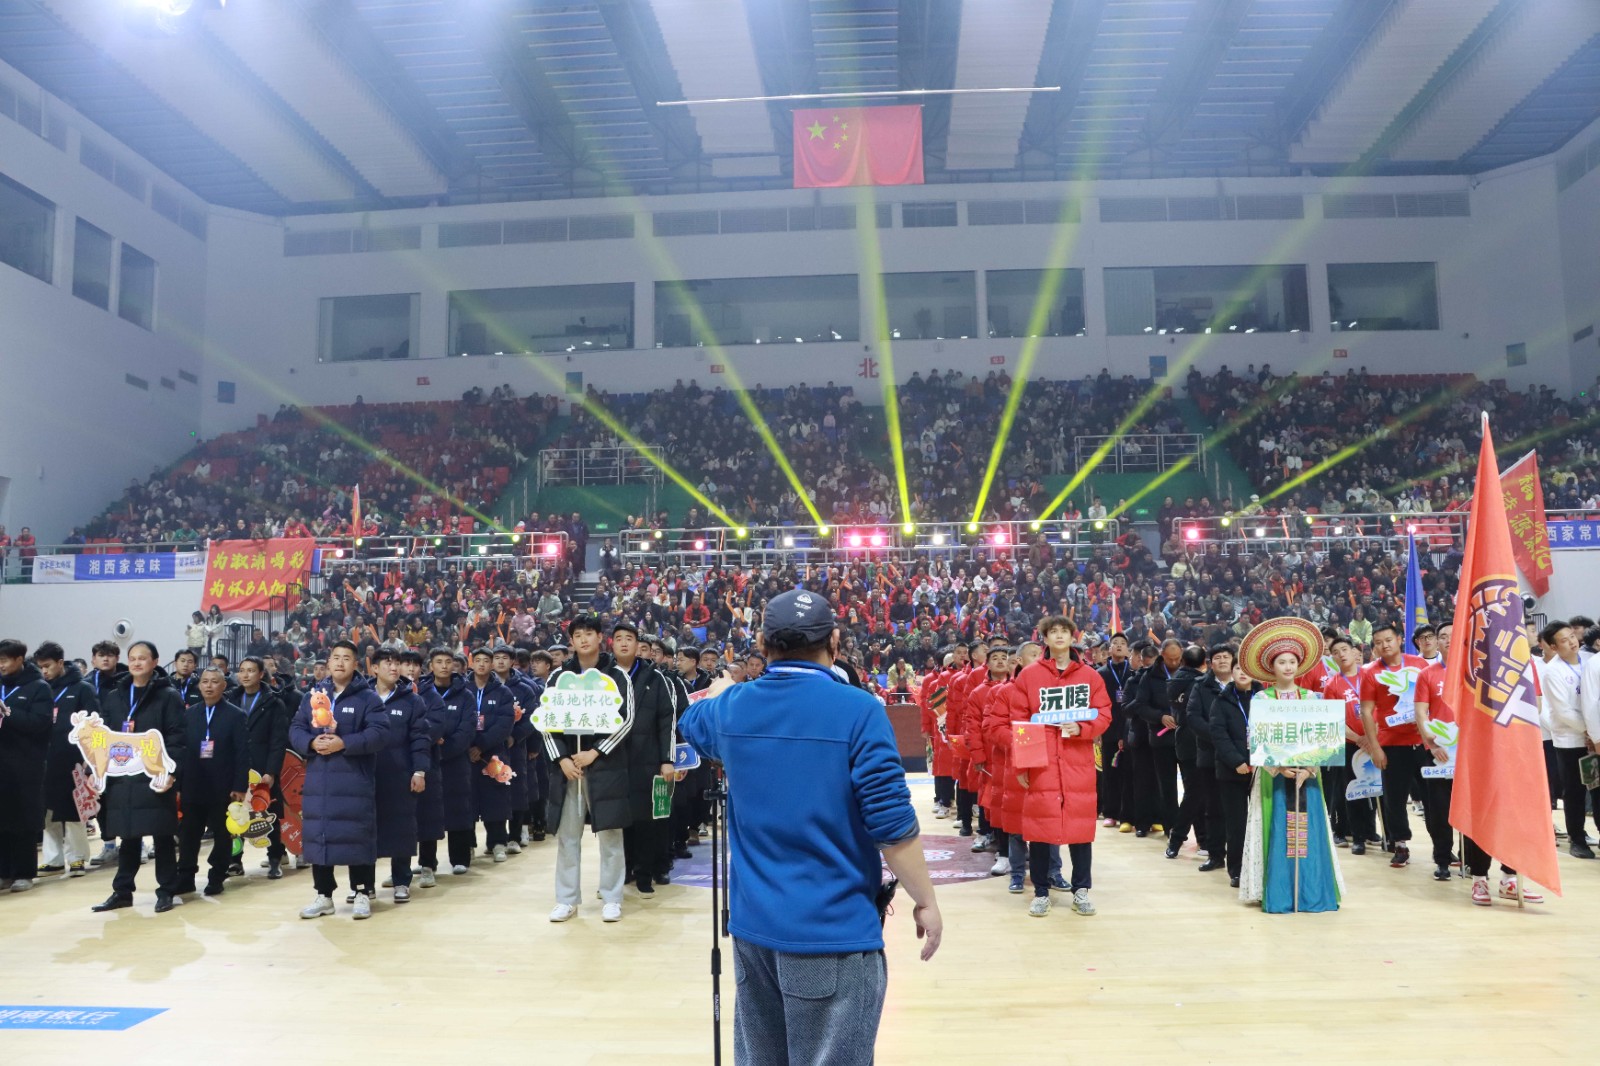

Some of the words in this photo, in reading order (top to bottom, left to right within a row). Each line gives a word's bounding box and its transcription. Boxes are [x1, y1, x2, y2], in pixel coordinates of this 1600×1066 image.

[858, 357, 879, 378] 北
[88, 558, 161, 575] 湘西家常味
[551, 692, 613, 707] 福地怀化
[1040, 684, 1090, 711] 沅陵
[543, 711, 610, 728] 德善辰溪
[1036, 710, 1093, 723] YUANLING
[1254, 721, 1341, 744] 溆浦县代表队
[91, 730, 107, 749] 新
[141, 739, 157, 757] 晃
